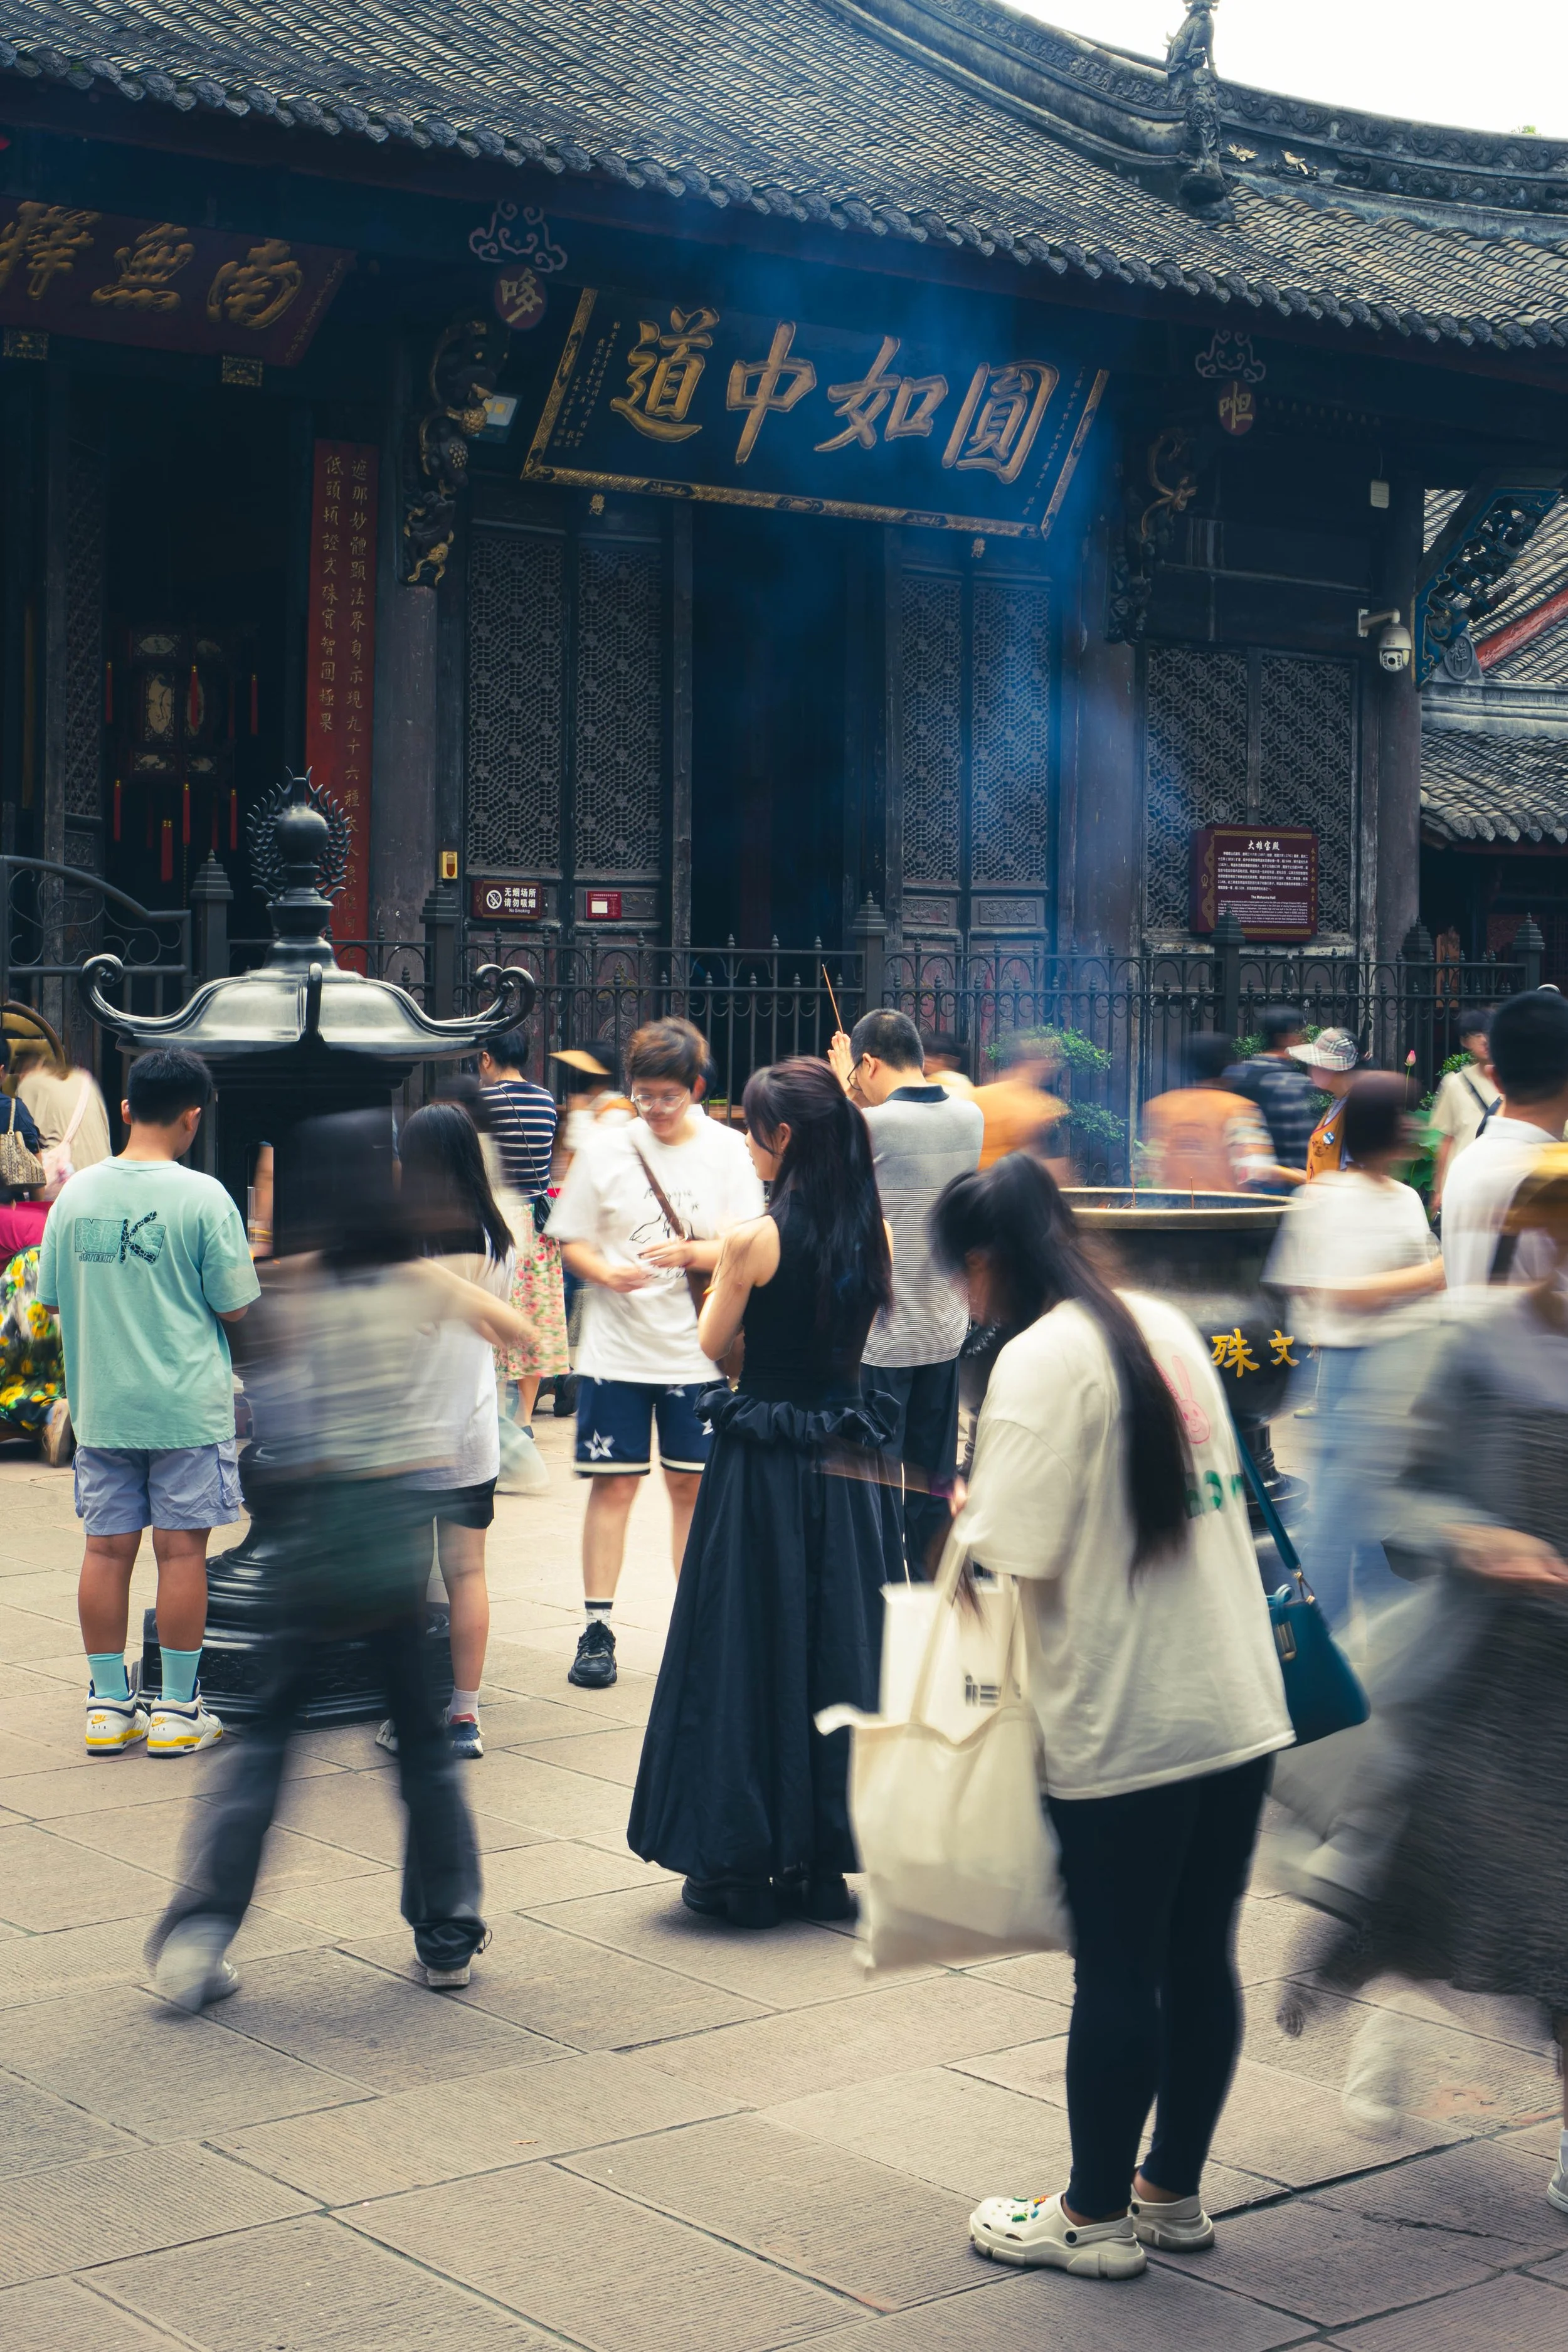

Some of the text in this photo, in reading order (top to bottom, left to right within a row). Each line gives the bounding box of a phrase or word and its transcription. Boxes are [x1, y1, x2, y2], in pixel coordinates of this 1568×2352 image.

[504, 887, 536, 898] 无烟场所
[504, 898, 536, 908] 请勿吸烟
